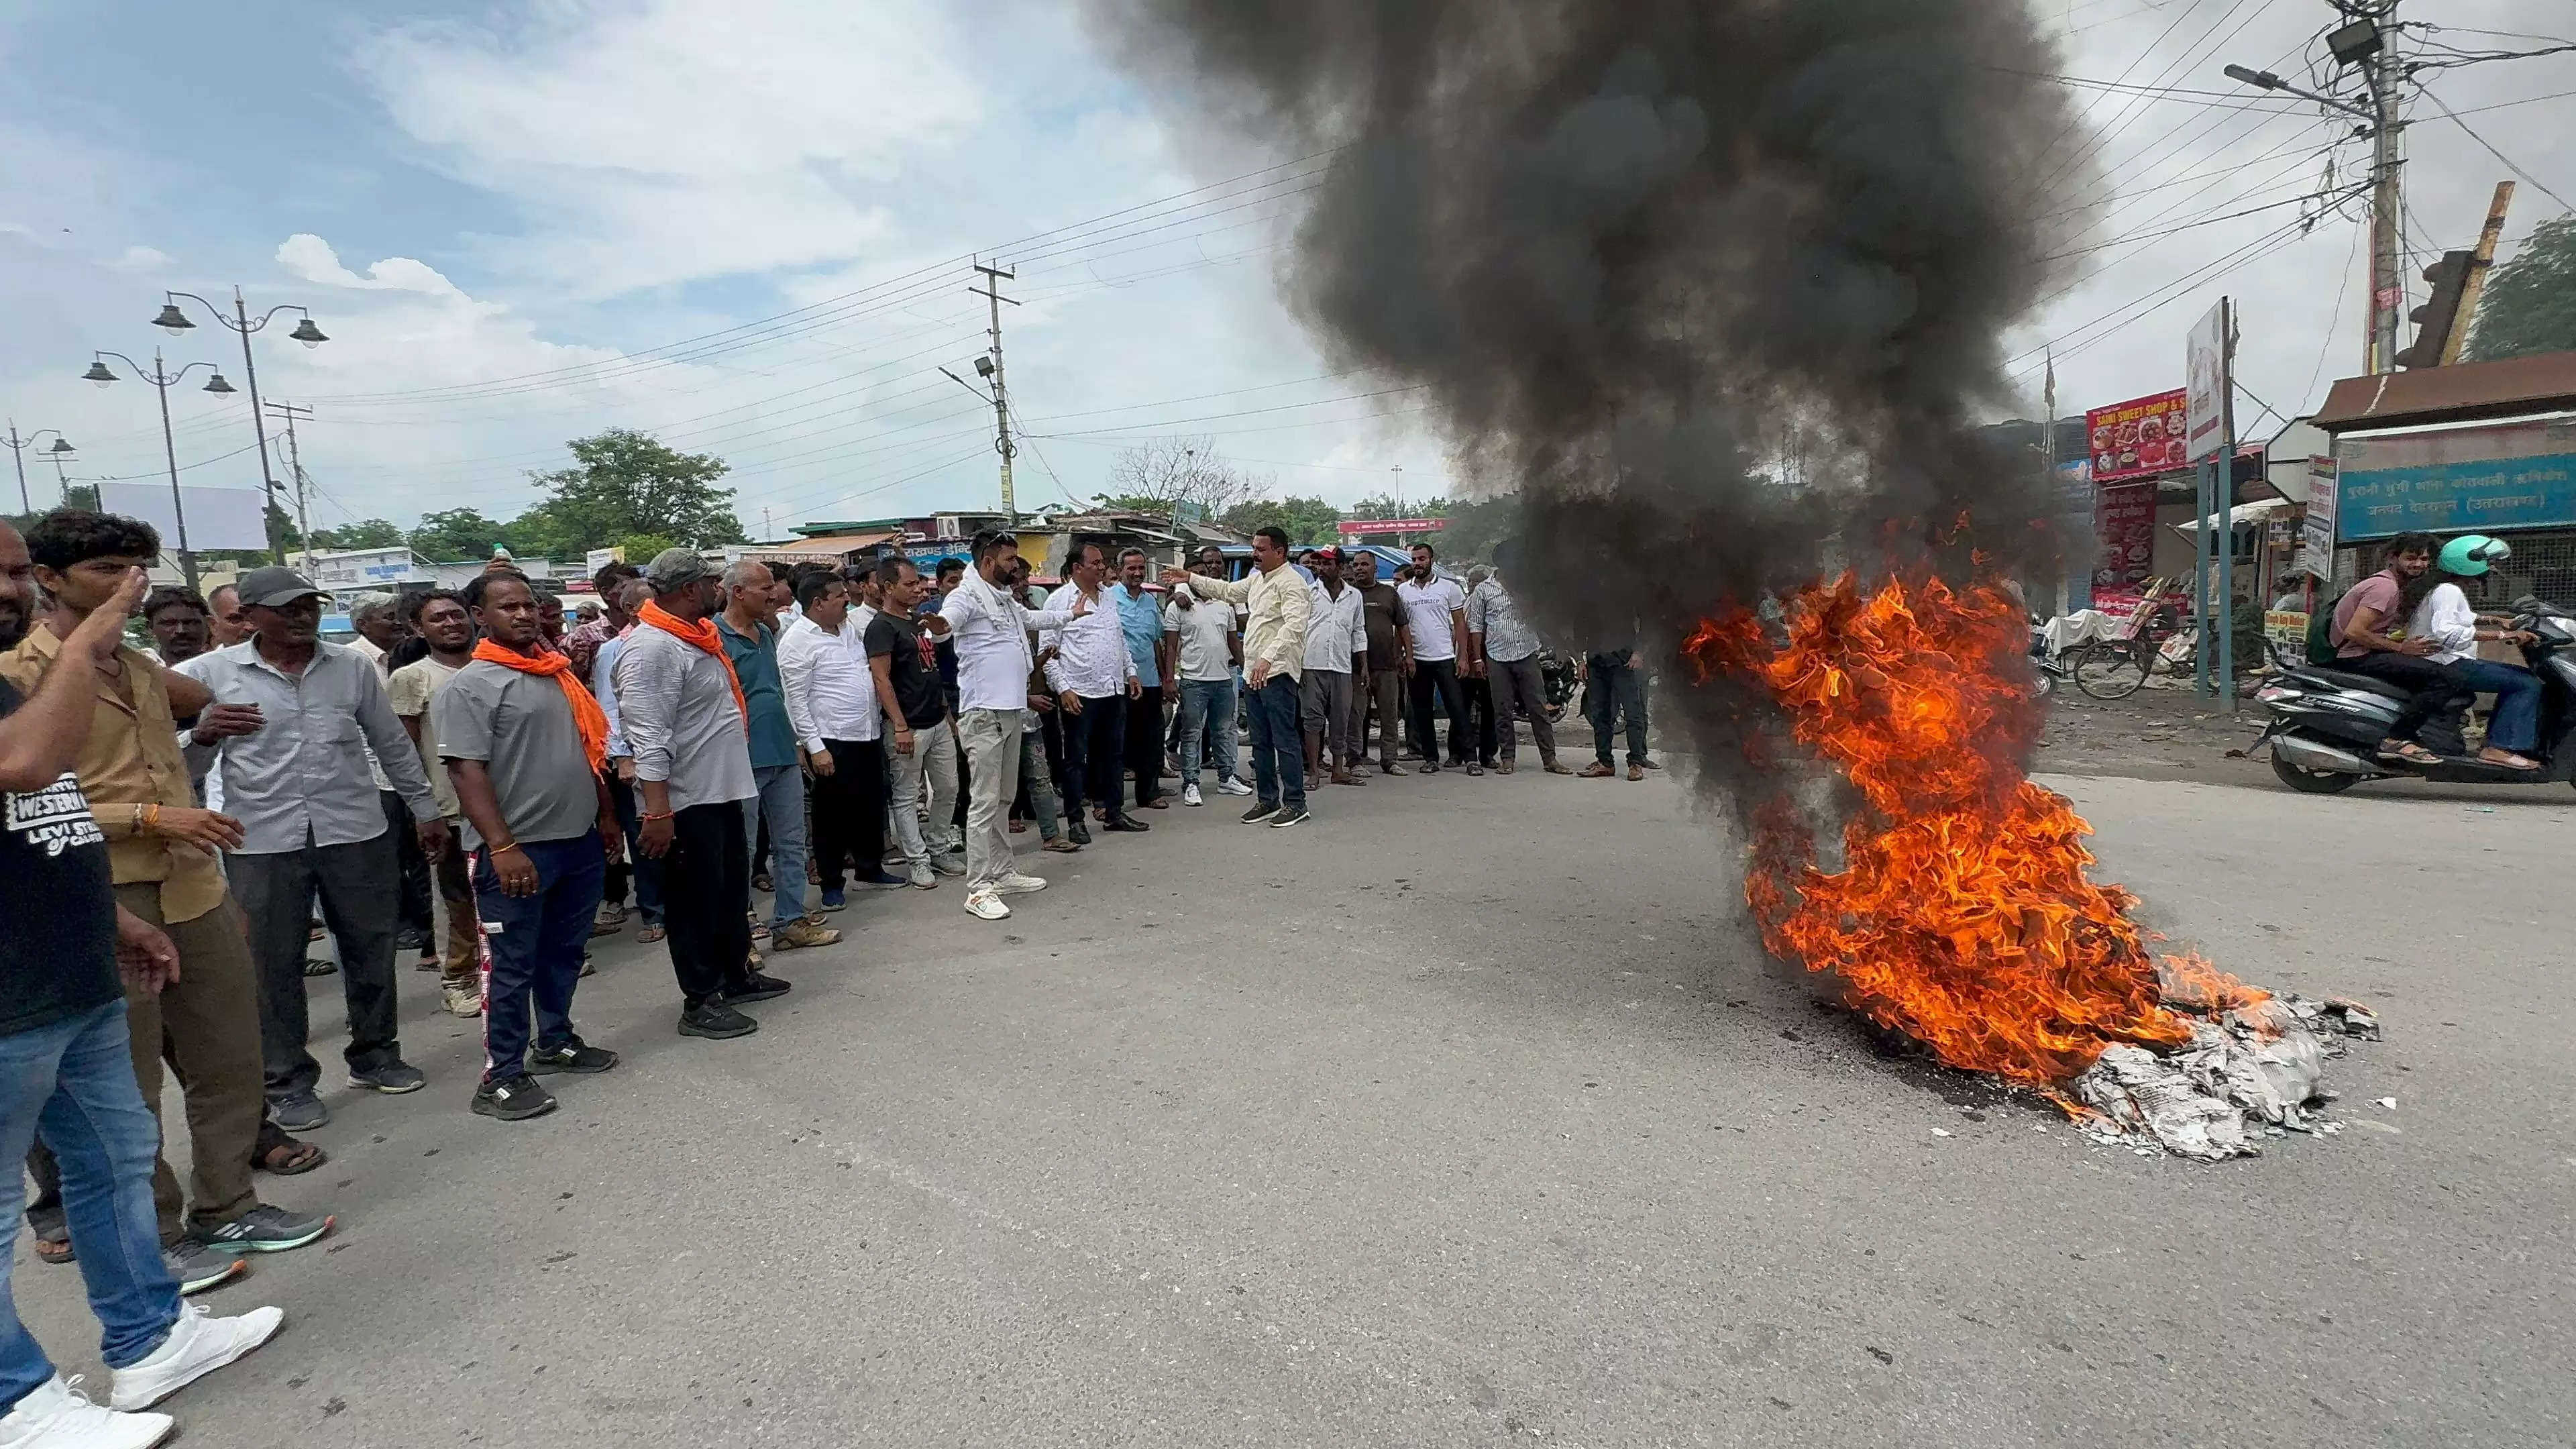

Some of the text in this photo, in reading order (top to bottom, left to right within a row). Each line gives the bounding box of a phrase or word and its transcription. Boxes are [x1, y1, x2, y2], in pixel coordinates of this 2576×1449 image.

[2118, 407, 2143, 422] SWEET
[2146, 400, 2168, 416] SHOP
[2171, 399, 2178, 409] &
[17, 792, 82, 819] WESTERN
[28, 822, 70, 845] LEVI
